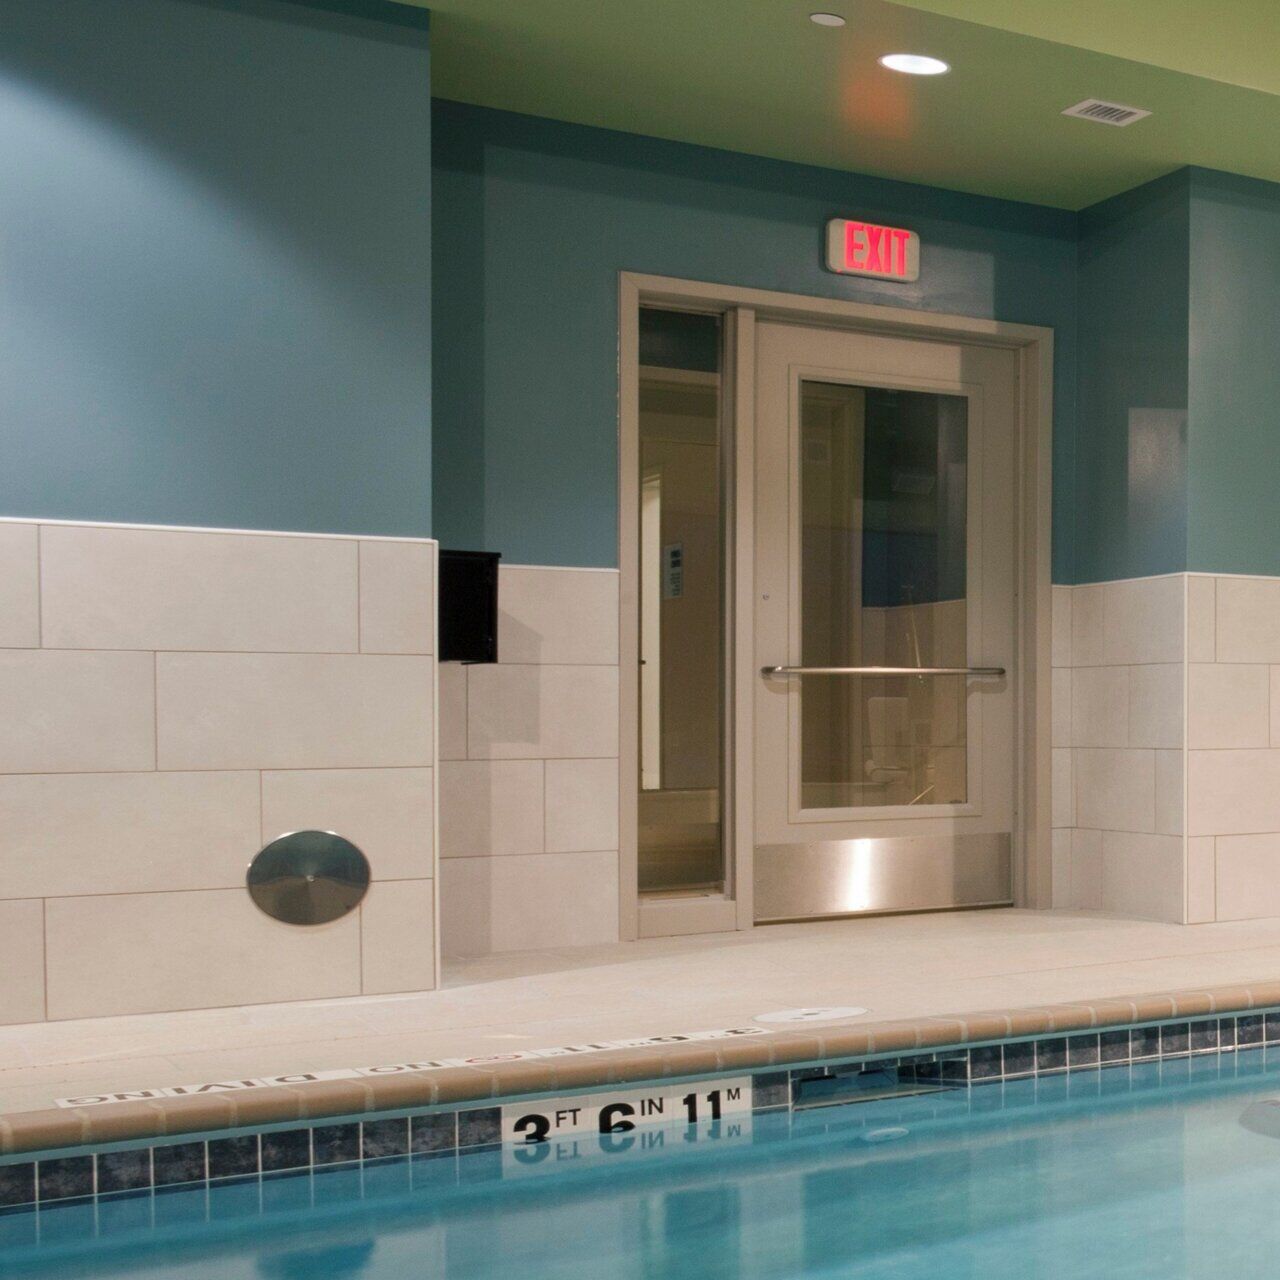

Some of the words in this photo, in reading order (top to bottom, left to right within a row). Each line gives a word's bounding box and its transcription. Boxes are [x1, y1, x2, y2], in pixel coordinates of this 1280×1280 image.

[844, 221, 911, 276] EXIT
[369, 1061, 443, 1073] NO
[66, 1073, 319, 1105] DIVING
[513, 1114, 551, 1146] 3
[556, 1108, 582, 1128] FT
[598, 1103, 636, 1134] 6
[641, 1097, 664, 1116] IN
[682, 1090, 721, 1123] 11
[727, 1087, 741, 1101] M
